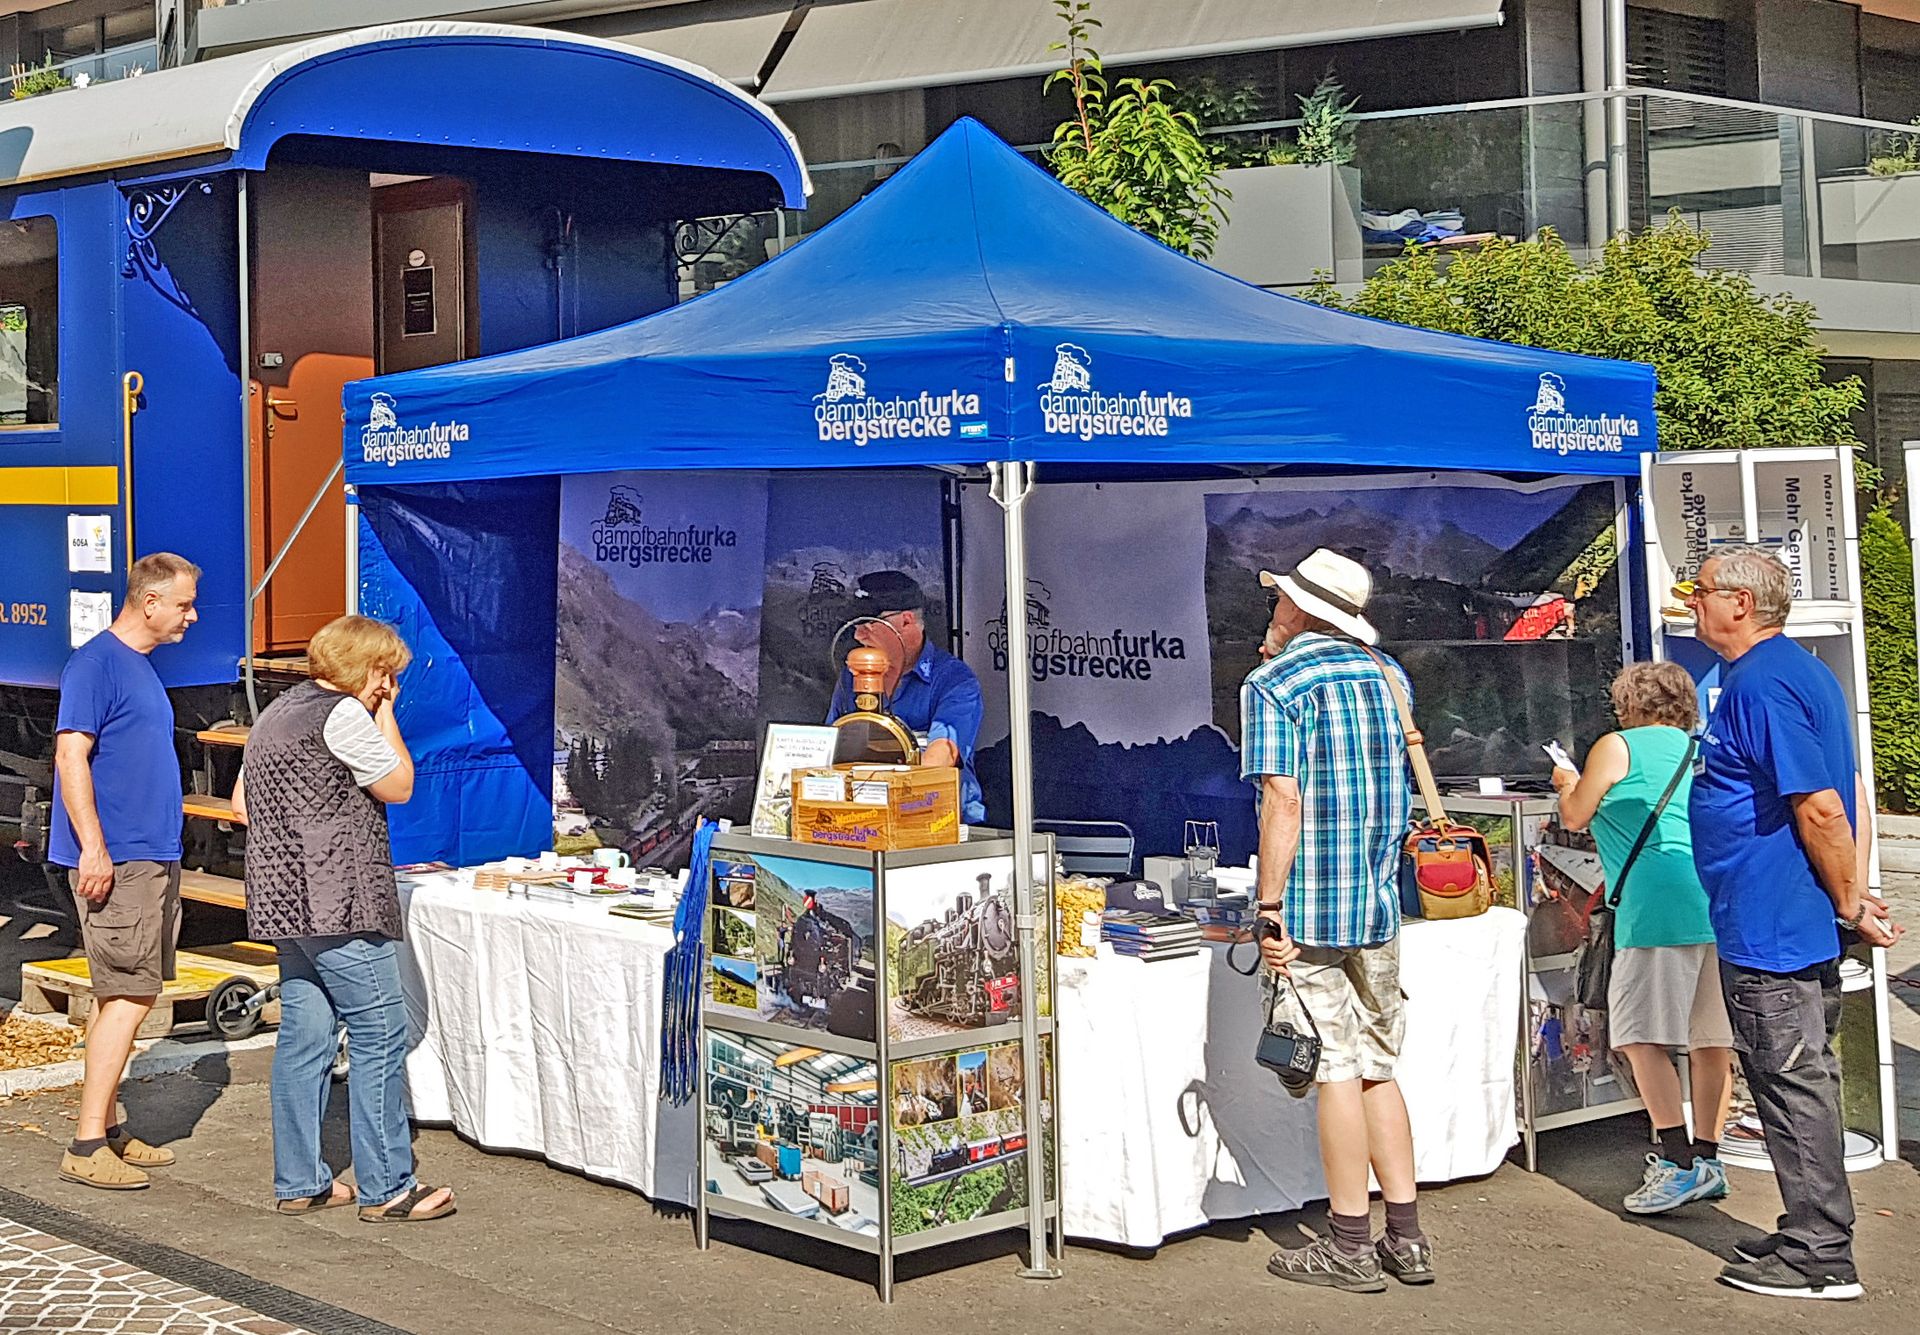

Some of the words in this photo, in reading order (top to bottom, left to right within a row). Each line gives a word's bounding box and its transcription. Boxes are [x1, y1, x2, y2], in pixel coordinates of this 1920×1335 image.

[815, 389, 980, 421] dampfbahnfurka
[1040, 390, 1192, 417] dampfbahnfurka
[361, 420, 469, 447] dampfbahnfurka
[818, 414, 951, 446] bergstrecke
[1044, 410, 1168, 441] bergstrecke
[1528, 411, 1639, 436] dampfbahnfurka
[363, 440, 451, 467] bergstrecke
[1532, 430, 1623, 455] bergstrecke
[1785, 477, 1801, 523] Mehr
[1823, 474, 1834, 521] Mehr
[592, 524, 737, 547] dampfbahnfurka
[1680, 471, 1699, 582] pfbahnfurka
[1693, 494, 1708, 560] strecke
[596, 544, 712, 568] bergstrecke
[1788, 528, 1804, 599] Genuss
[11, 602, 48, 626] 8952
[988, 628, 1186, 660] dapfbahnfurka
[993, 650, 1152, 682] bgstrecke
